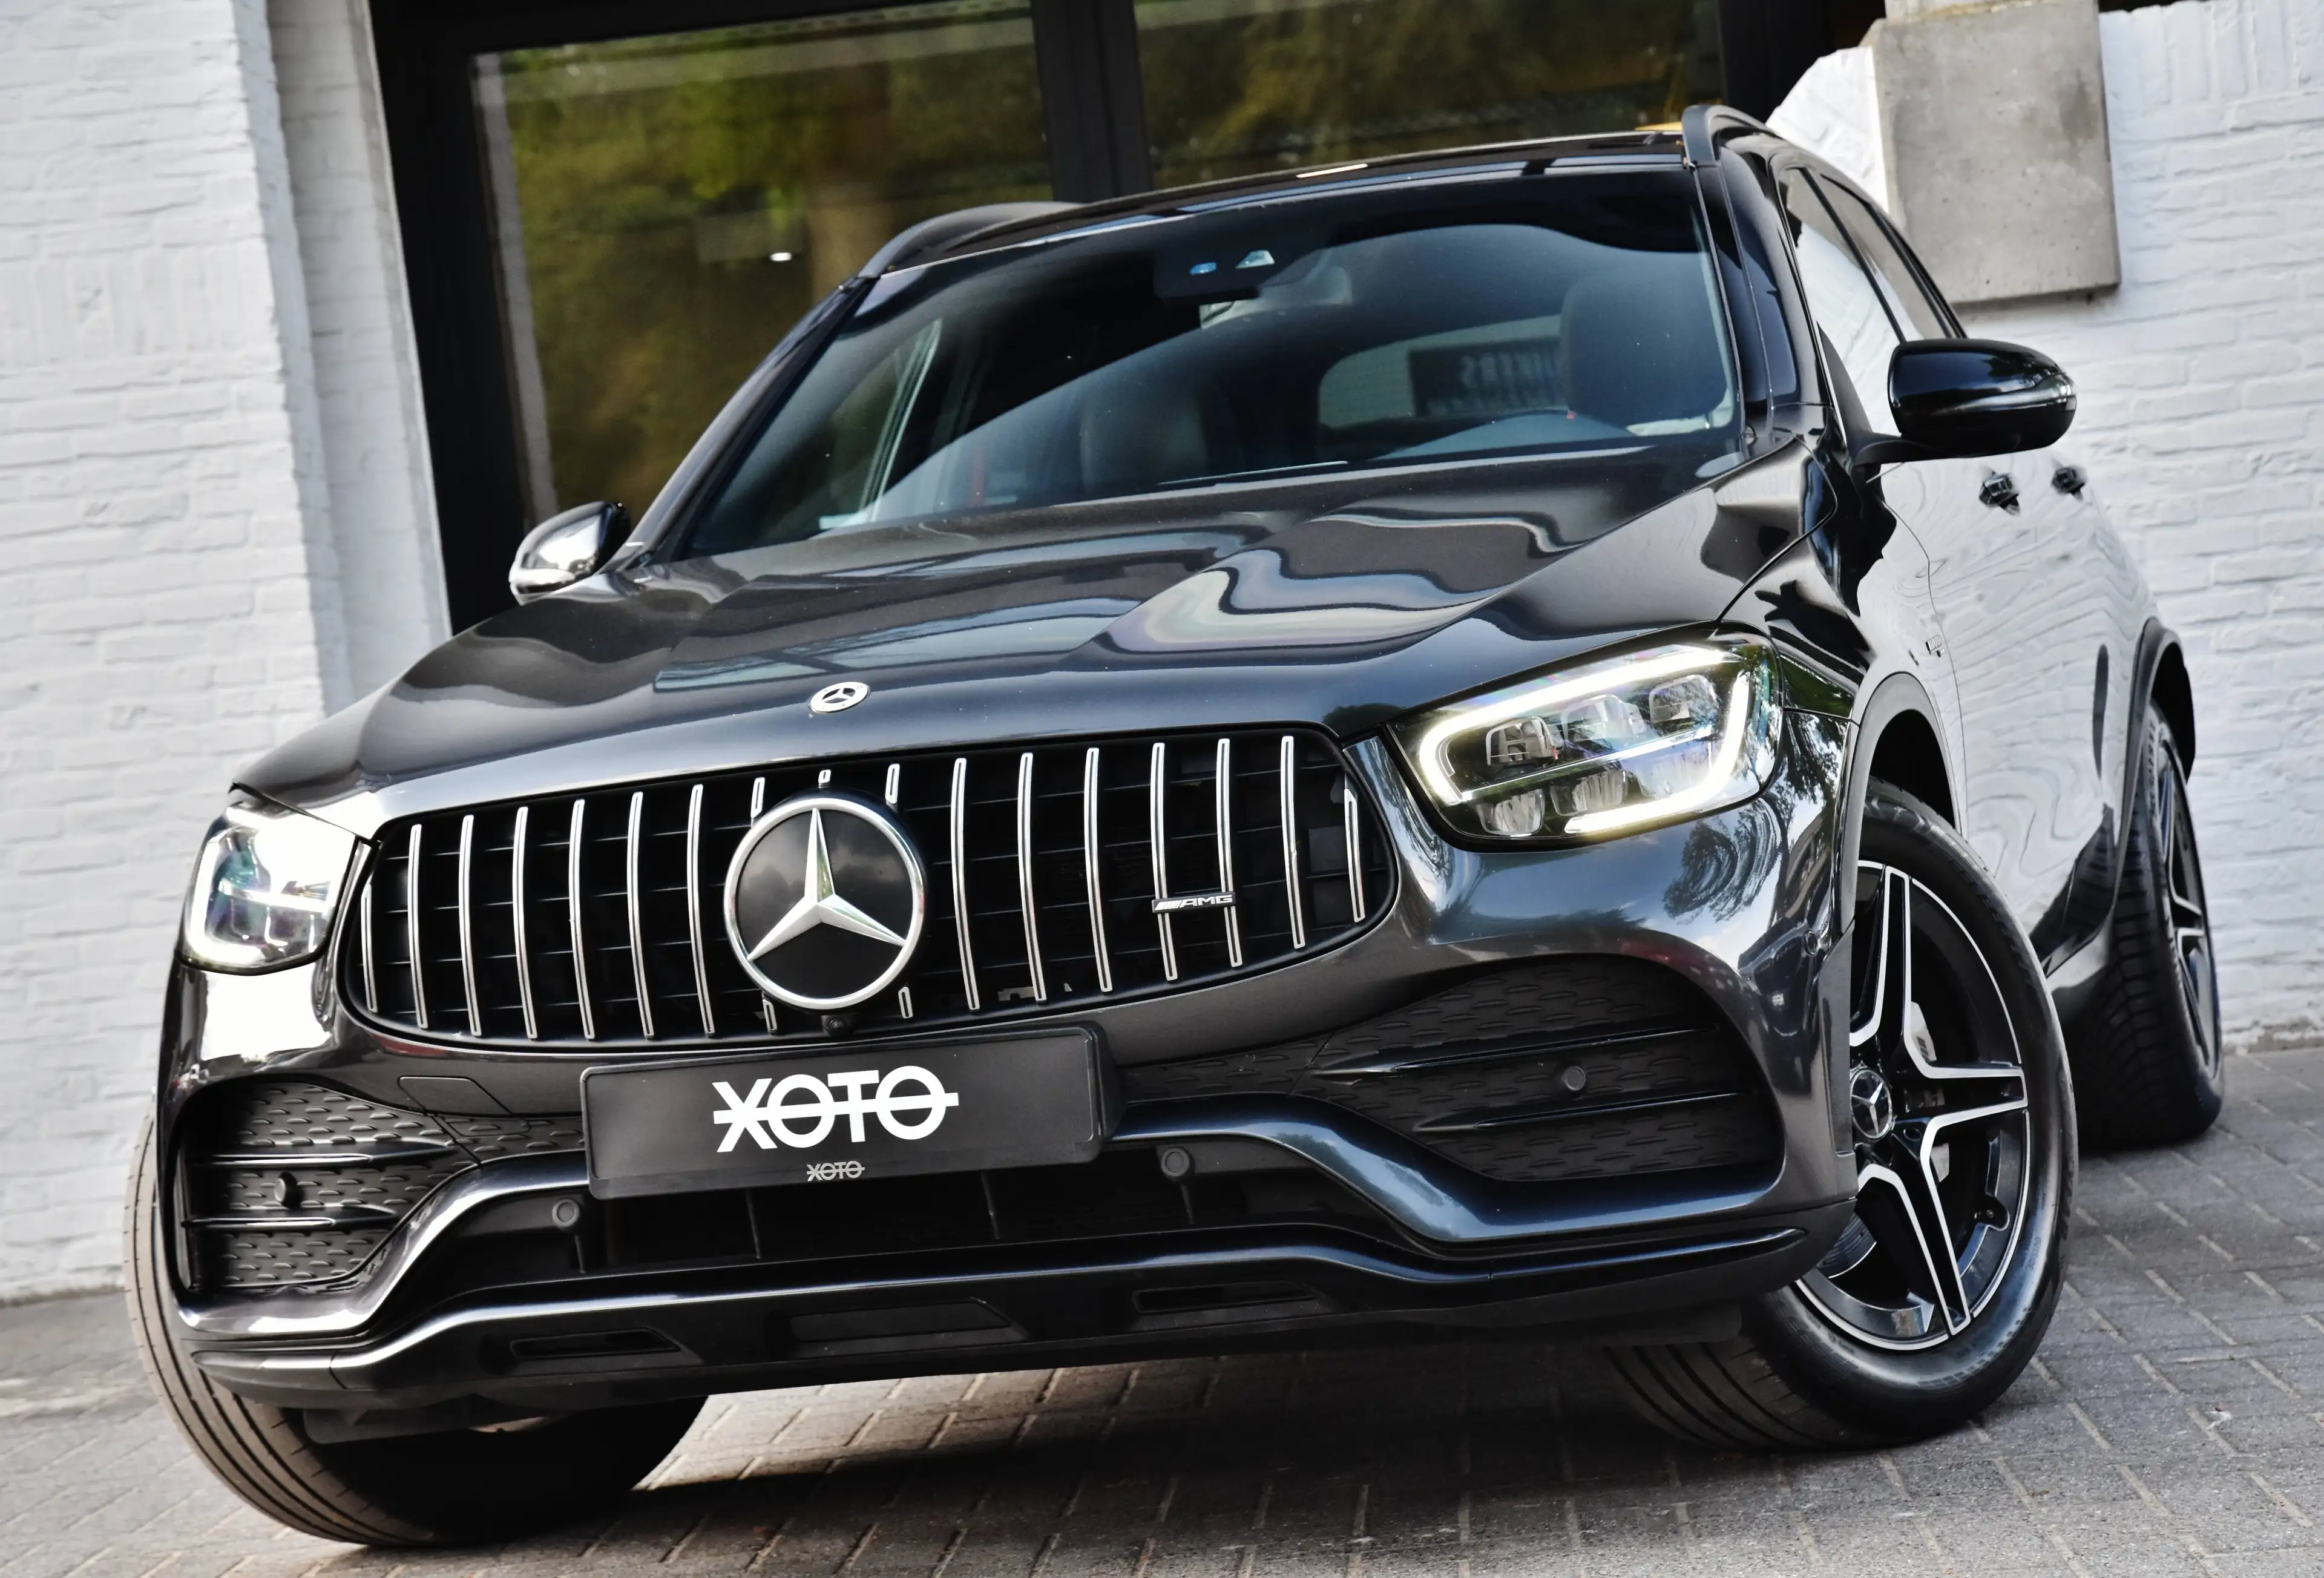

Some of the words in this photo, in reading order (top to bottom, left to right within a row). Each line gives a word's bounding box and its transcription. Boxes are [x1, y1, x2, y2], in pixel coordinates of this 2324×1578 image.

[1179, 895, 1233, 908] AMG
[712, 1065, 959, 1153] XOTO
[807, 1160, 865, 1182] XOTO
